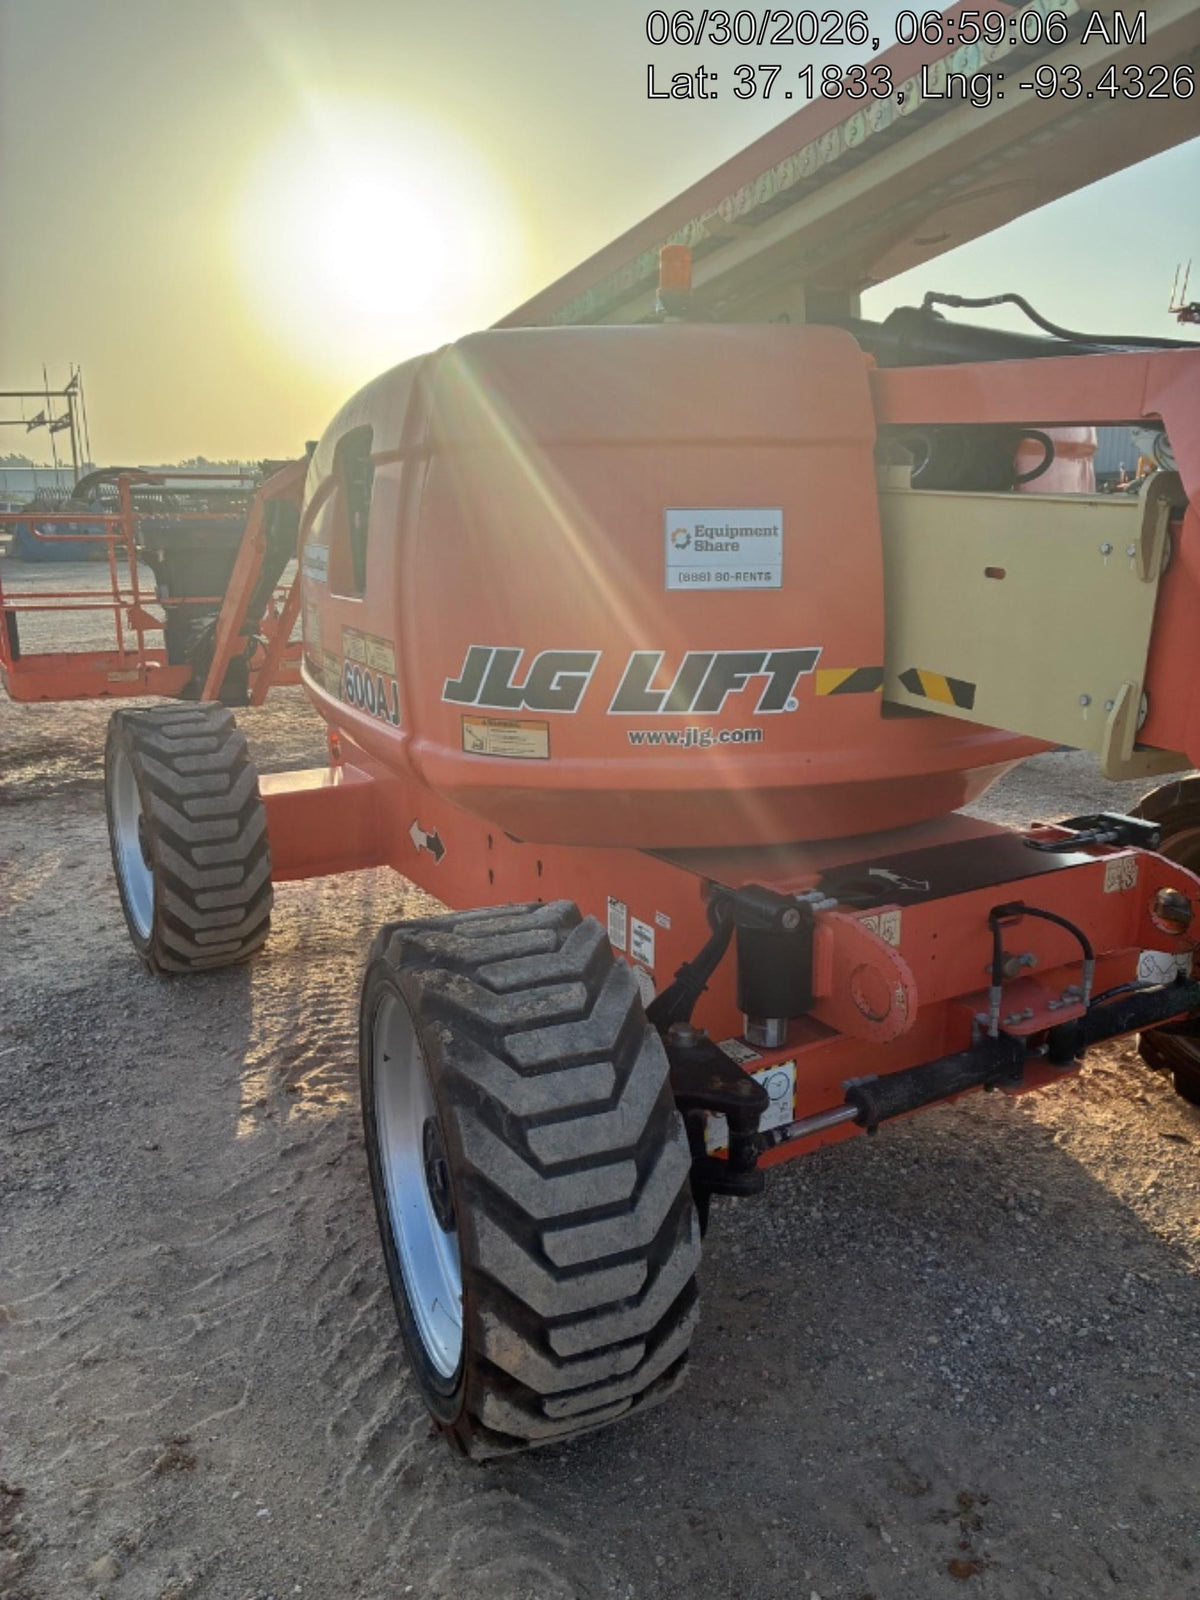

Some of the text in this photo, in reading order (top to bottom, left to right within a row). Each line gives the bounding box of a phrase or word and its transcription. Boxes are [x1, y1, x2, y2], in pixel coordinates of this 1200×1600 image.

[693, 524, 780, 540] Equipment
[693, 540, 741, 553] Share
[714, 571, 773, 583] 80-RENTS
[441, 645, 602, 714] JLG
[343, 658, 402, 728] 600AJ
[626, 727, 764, 749] www.jlg.com
